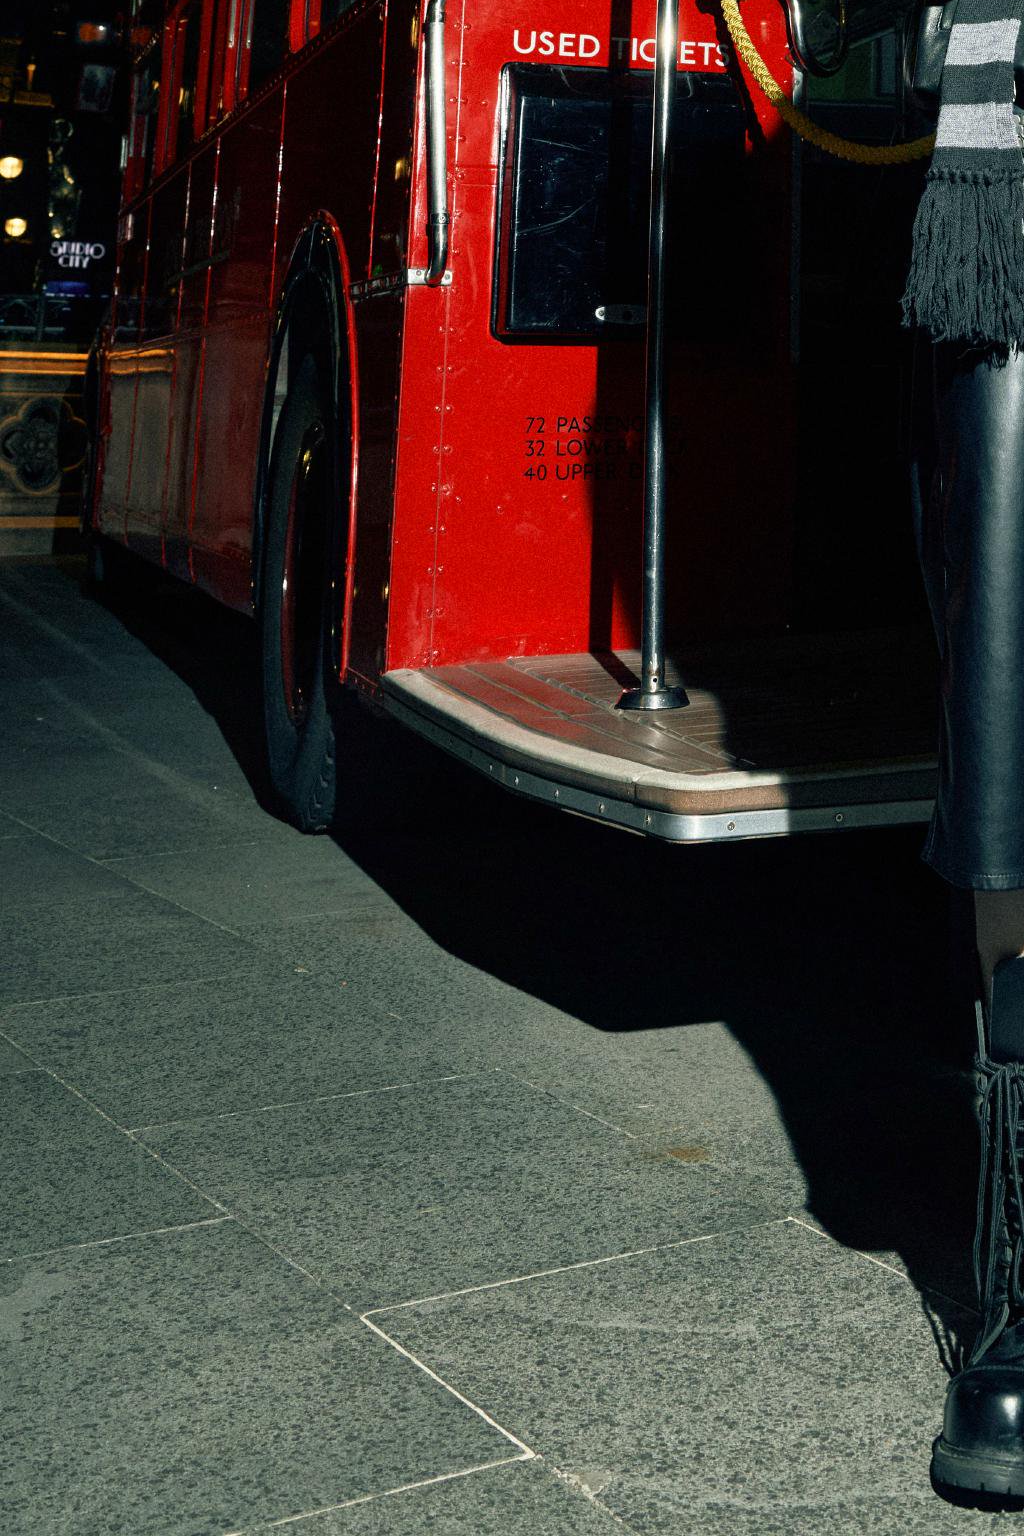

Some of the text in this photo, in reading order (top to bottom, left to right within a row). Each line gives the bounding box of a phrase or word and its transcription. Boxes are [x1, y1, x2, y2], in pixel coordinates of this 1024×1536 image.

[513, 29, 730, 67] USED TICETS
[49, 240, 106, 260] STUDIO
[57, 254, 90, 270] CITY
[526, 417, 546, 434] 72
[525, 439, 546, 457] 32
[523, 464, 548, 481] 40
